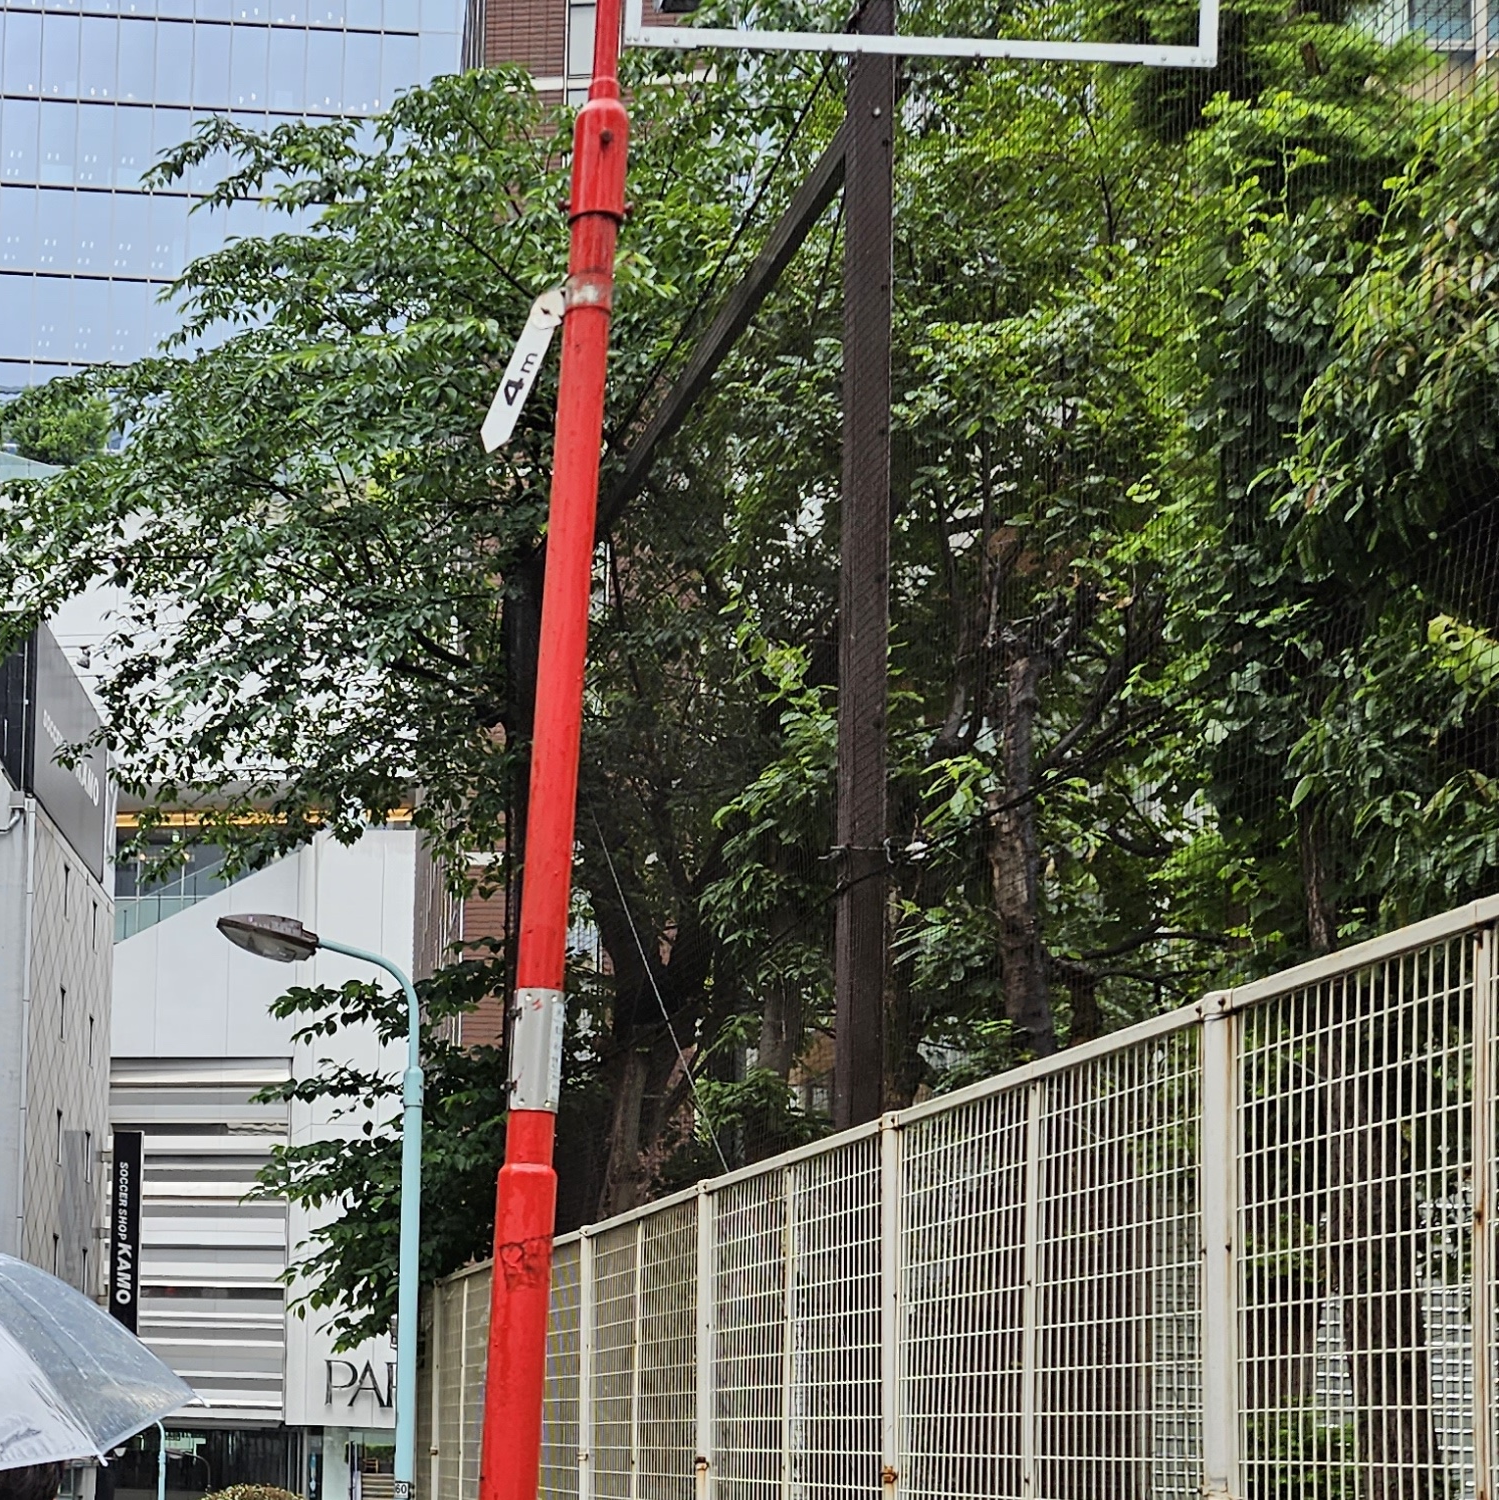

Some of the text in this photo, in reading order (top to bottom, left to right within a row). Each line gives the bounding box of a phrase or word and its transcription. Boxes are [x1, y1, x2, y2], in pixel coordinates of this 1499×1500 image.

[116, 1161, 132, 1305] SOCCER SHOP KAMO
